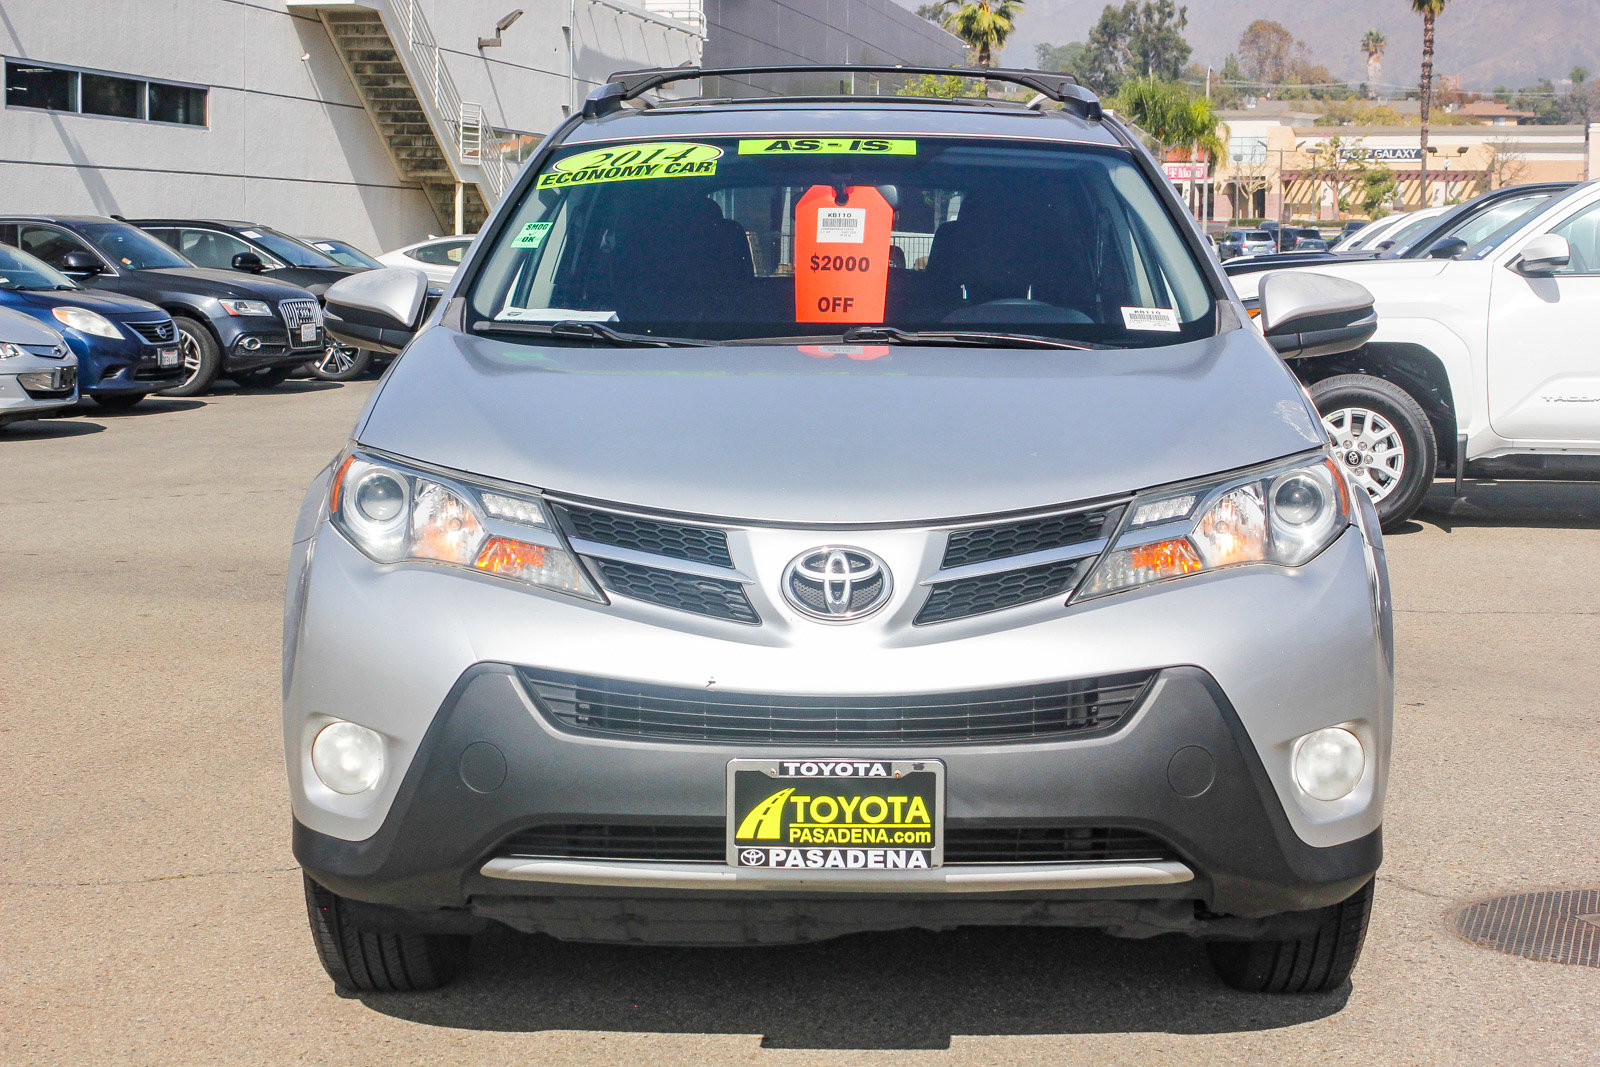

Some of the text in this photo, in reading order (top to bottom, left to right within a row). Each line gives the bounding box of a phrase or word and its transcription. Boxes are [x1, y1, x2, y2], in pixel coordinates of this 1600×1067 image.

[764, 140, 893, 152] AS-IS
[1342, 149, 1417, 159] GOF GALAXY
[581, 146, 698, 169] 2014
[541, 161, 715, 186] ECONOMY CAR
[525, 223, 550, 231] SMOG
[810, 253, 870, 273] $2000
[817, 296, 854, 313] OFF
[783, 762, 887, 776] TOYOTA
[790, 796, 931, 823] TOYOTA
[789, 828, 931, 843] PASADENA.com
[769, 849, 928, 868] PASADENA
